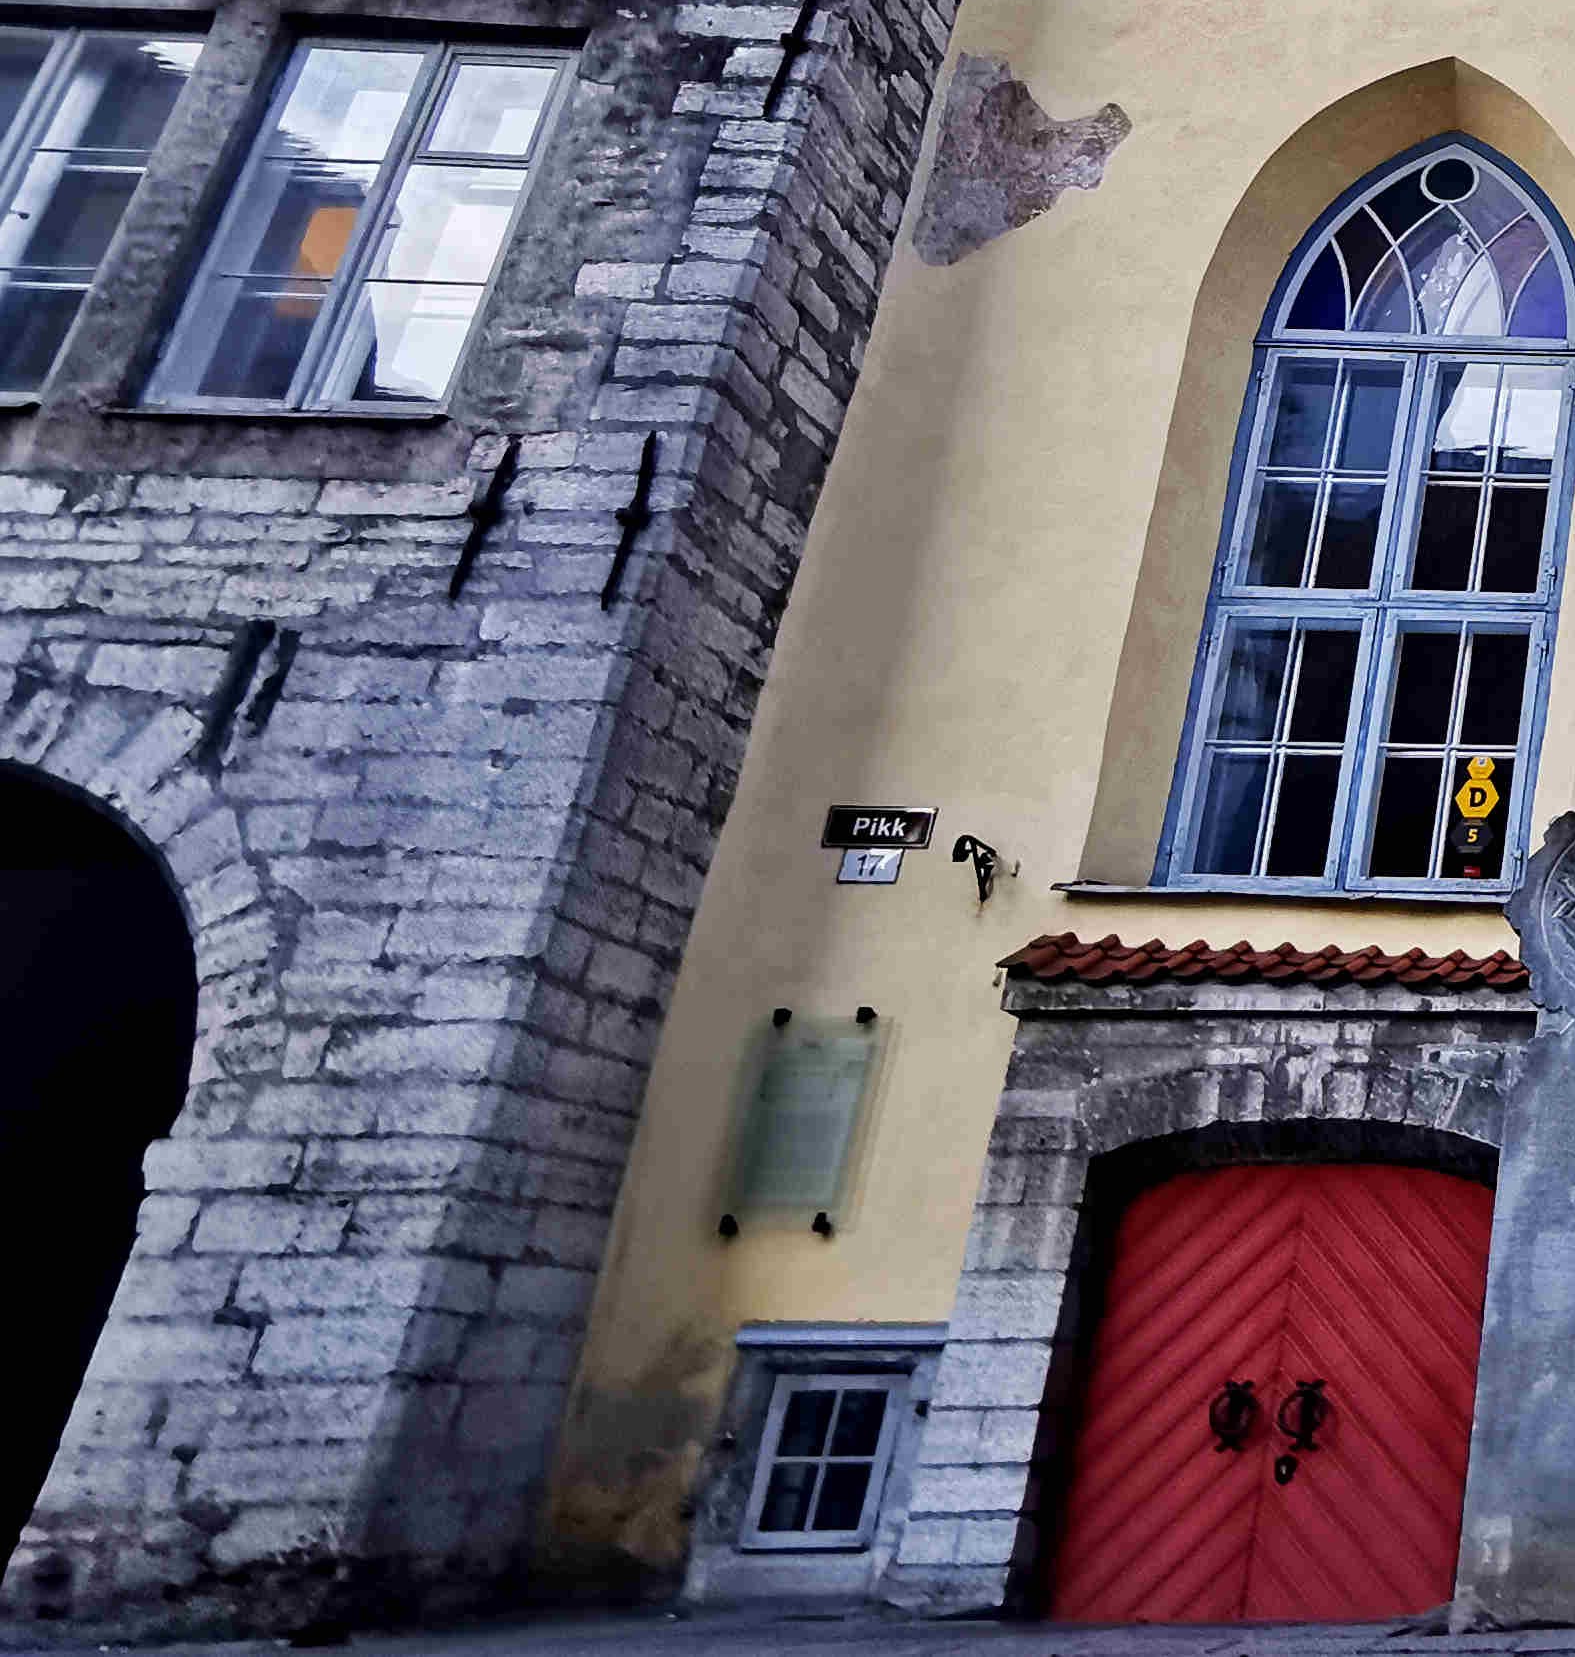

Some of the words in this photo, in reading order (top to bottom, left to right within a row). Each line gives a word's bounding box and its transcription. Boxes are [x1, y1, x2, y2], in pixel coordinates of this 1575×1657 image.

[1469, 787, 1488, 808] D
[852, 817, 907, 837] Pikk
[857, 854, 885, 877] 17
